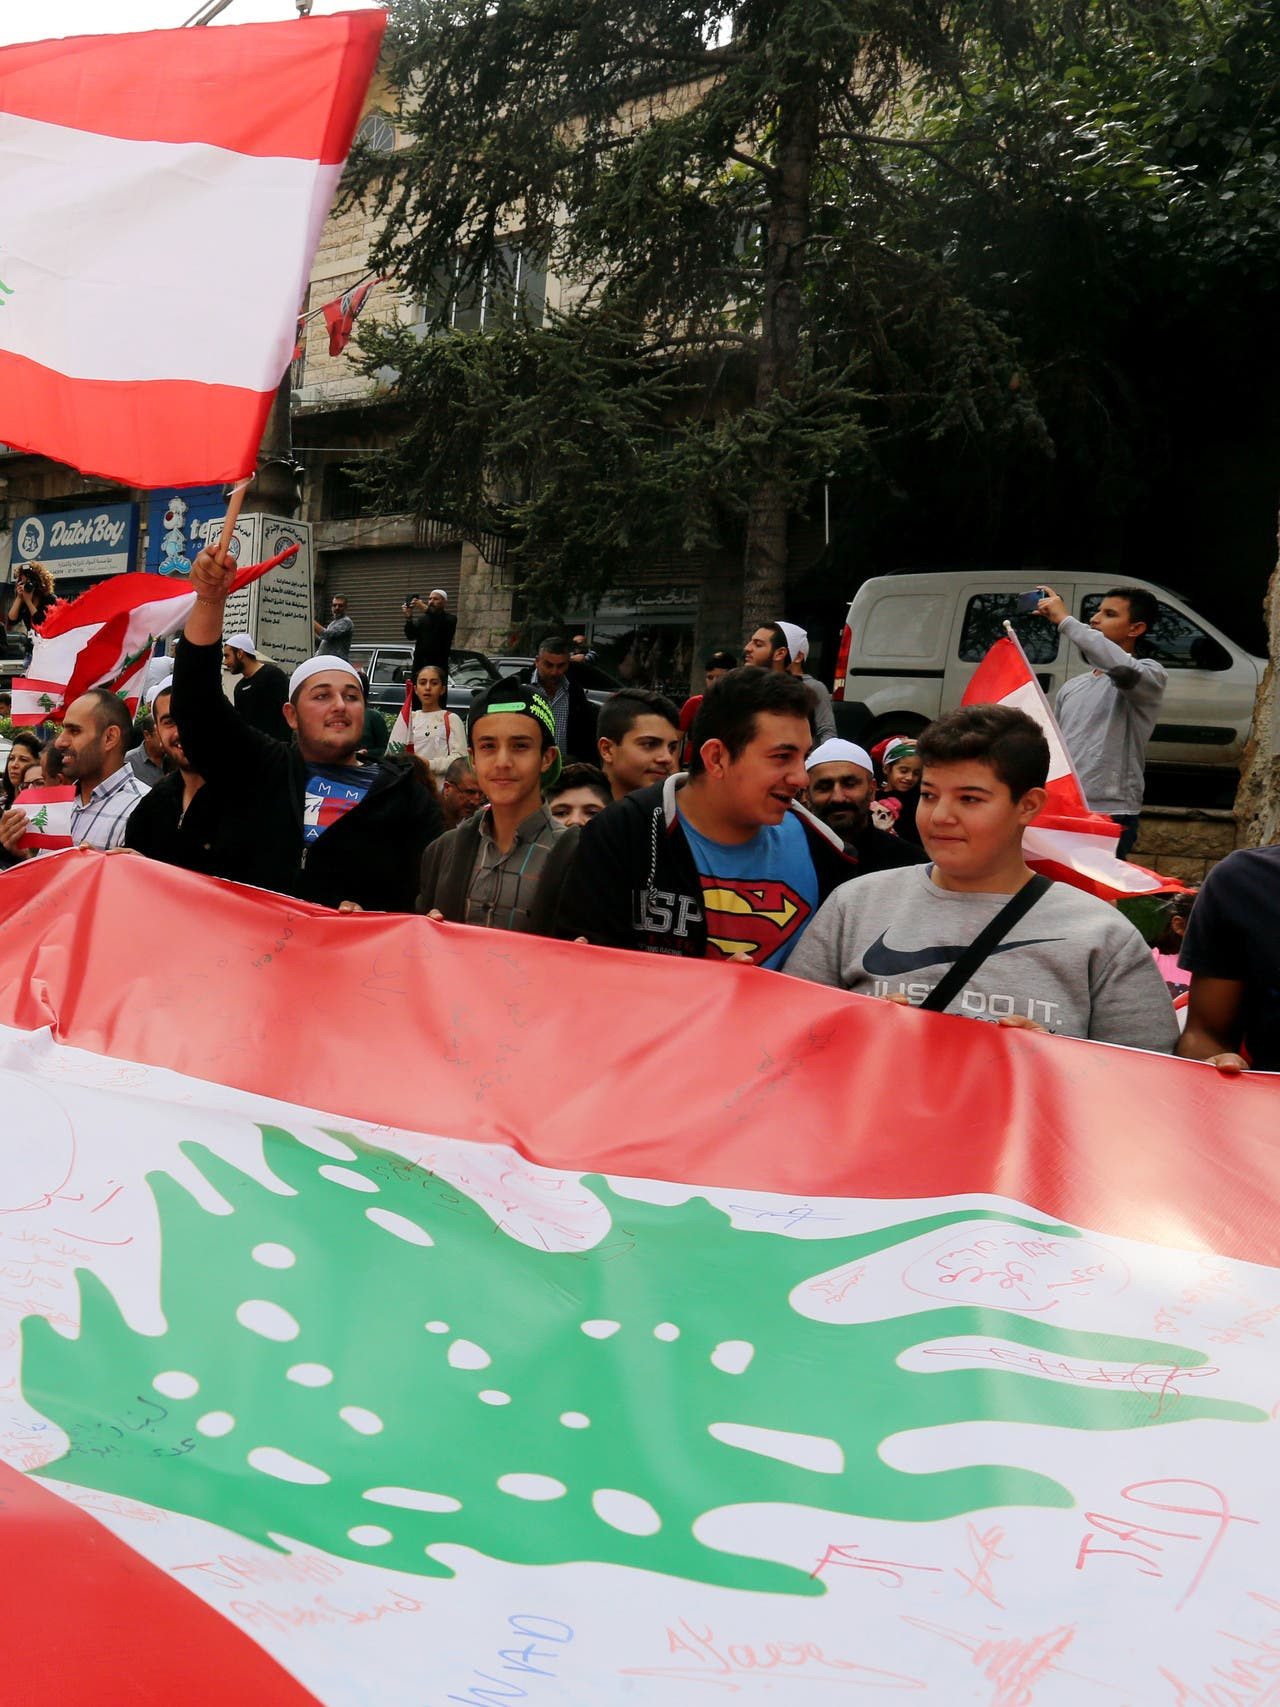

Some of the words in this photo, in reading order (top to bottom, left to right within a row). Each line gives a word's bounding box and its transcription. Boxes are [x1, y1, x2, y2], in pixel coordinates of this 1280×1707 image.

[50, 519, 93, 547] Dutch
[93, 514, 125, 547] Boy
[868, 981, 937, 1005] JUS
[961, 990, 1015, 1017] DO
